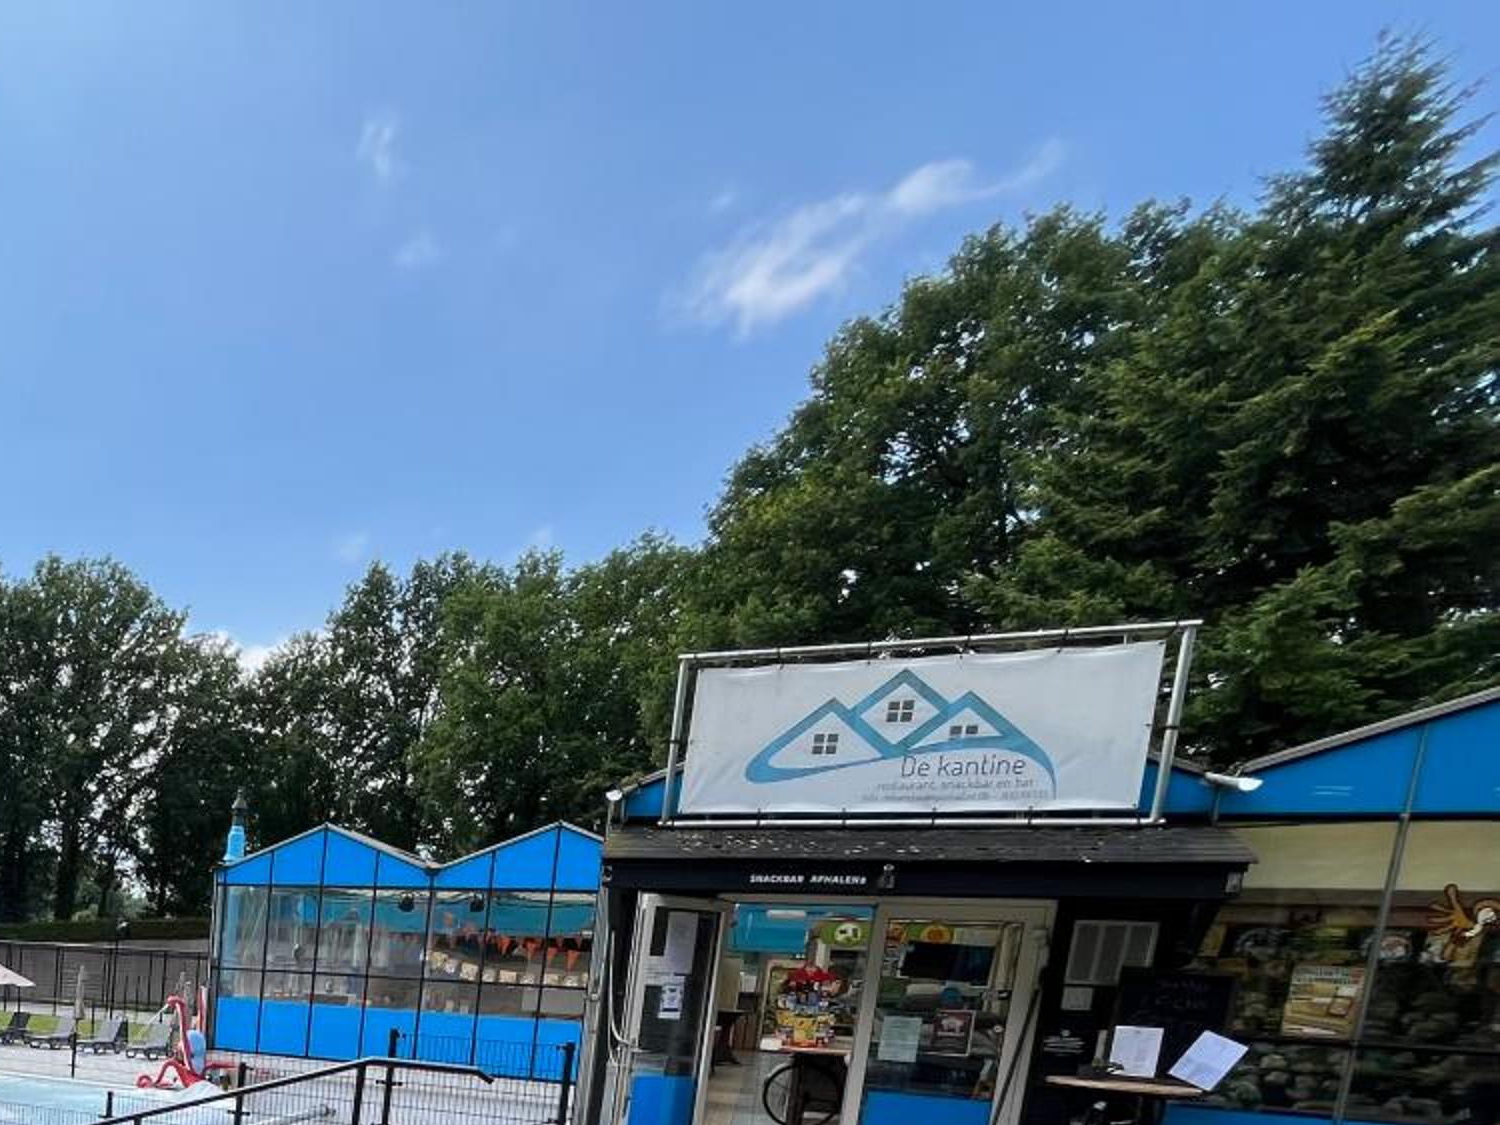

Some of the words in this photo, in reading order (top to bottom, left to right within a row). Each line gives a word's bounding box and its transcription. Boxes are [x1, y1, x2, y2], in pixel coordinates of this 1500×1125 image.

[901, 755, 930, 777] De
[937, 755, 1026, 777] kantine
[750, 874, 804, 884] SNACKBAR
